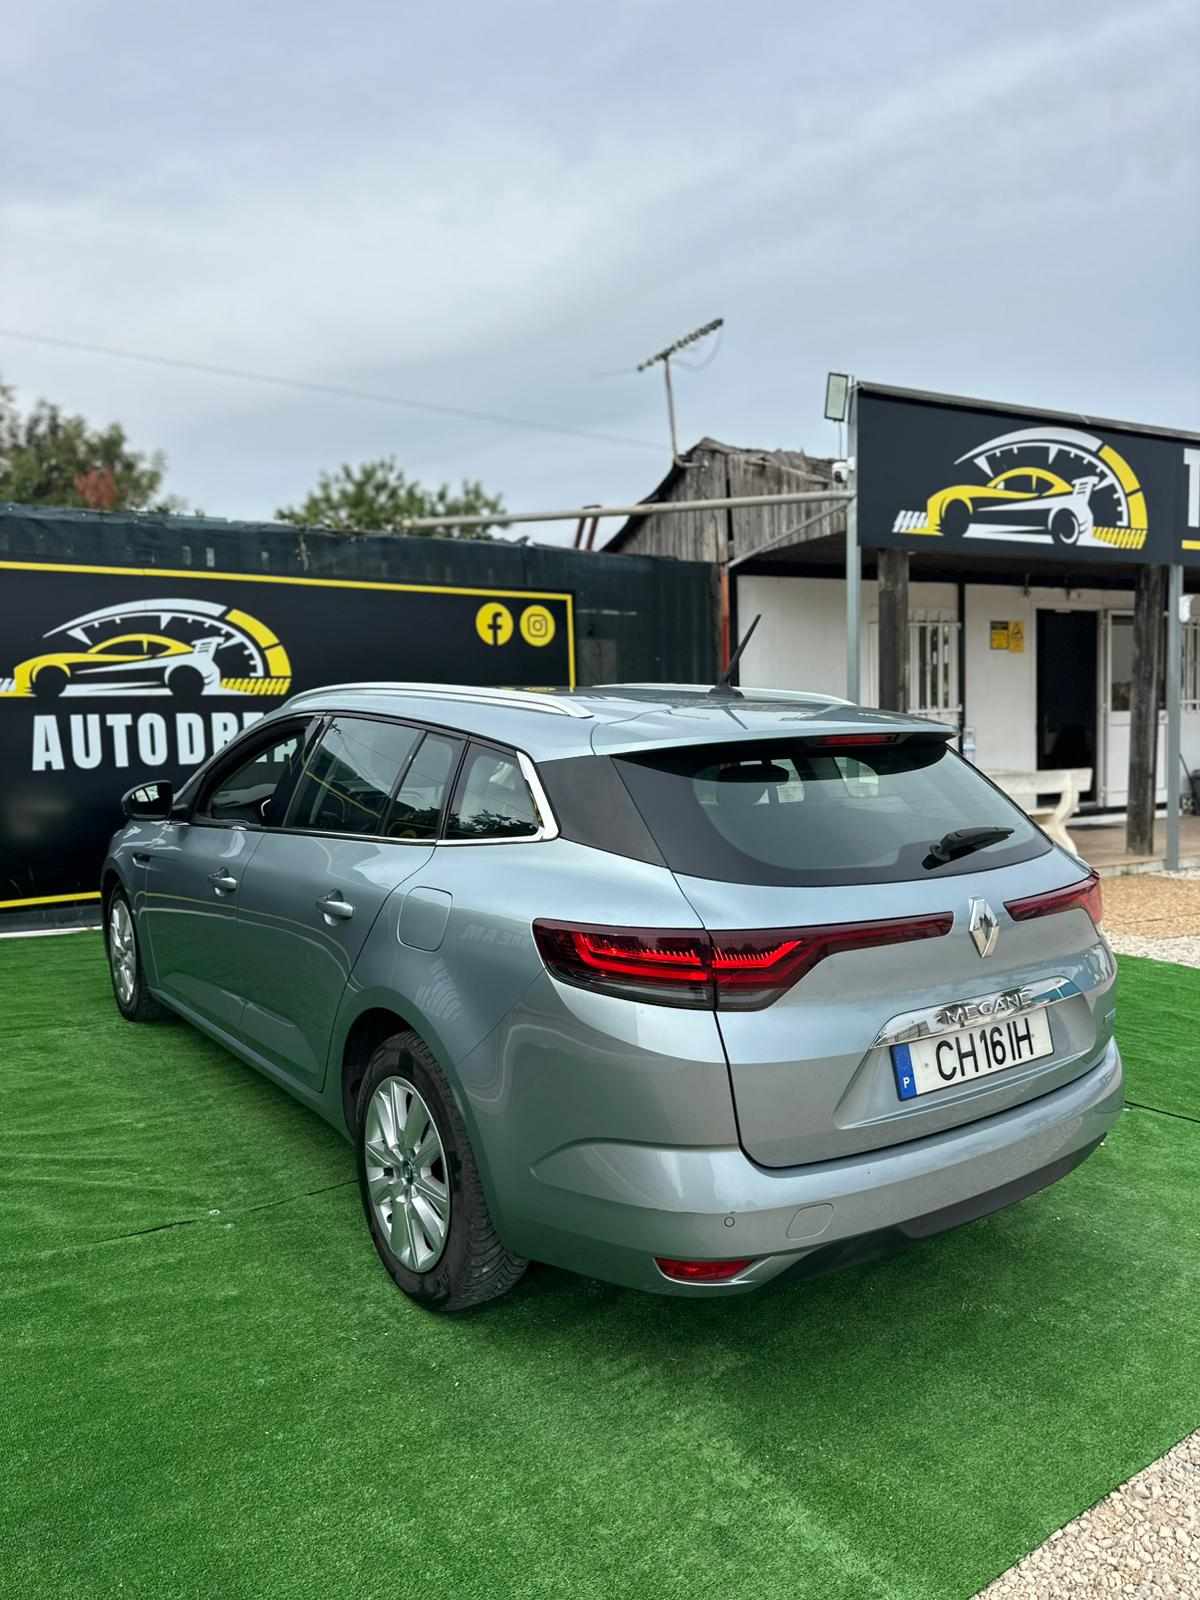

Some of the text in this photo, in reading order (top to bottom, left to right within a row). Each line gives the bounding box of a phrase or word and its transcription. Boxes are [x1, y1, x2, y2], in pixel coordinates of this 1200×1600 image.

[944, 989, 1033, 1024] MEGANE
[936, 1017, 1034, 1081] CH16IH
[903, 1076, 910, 1088] P
